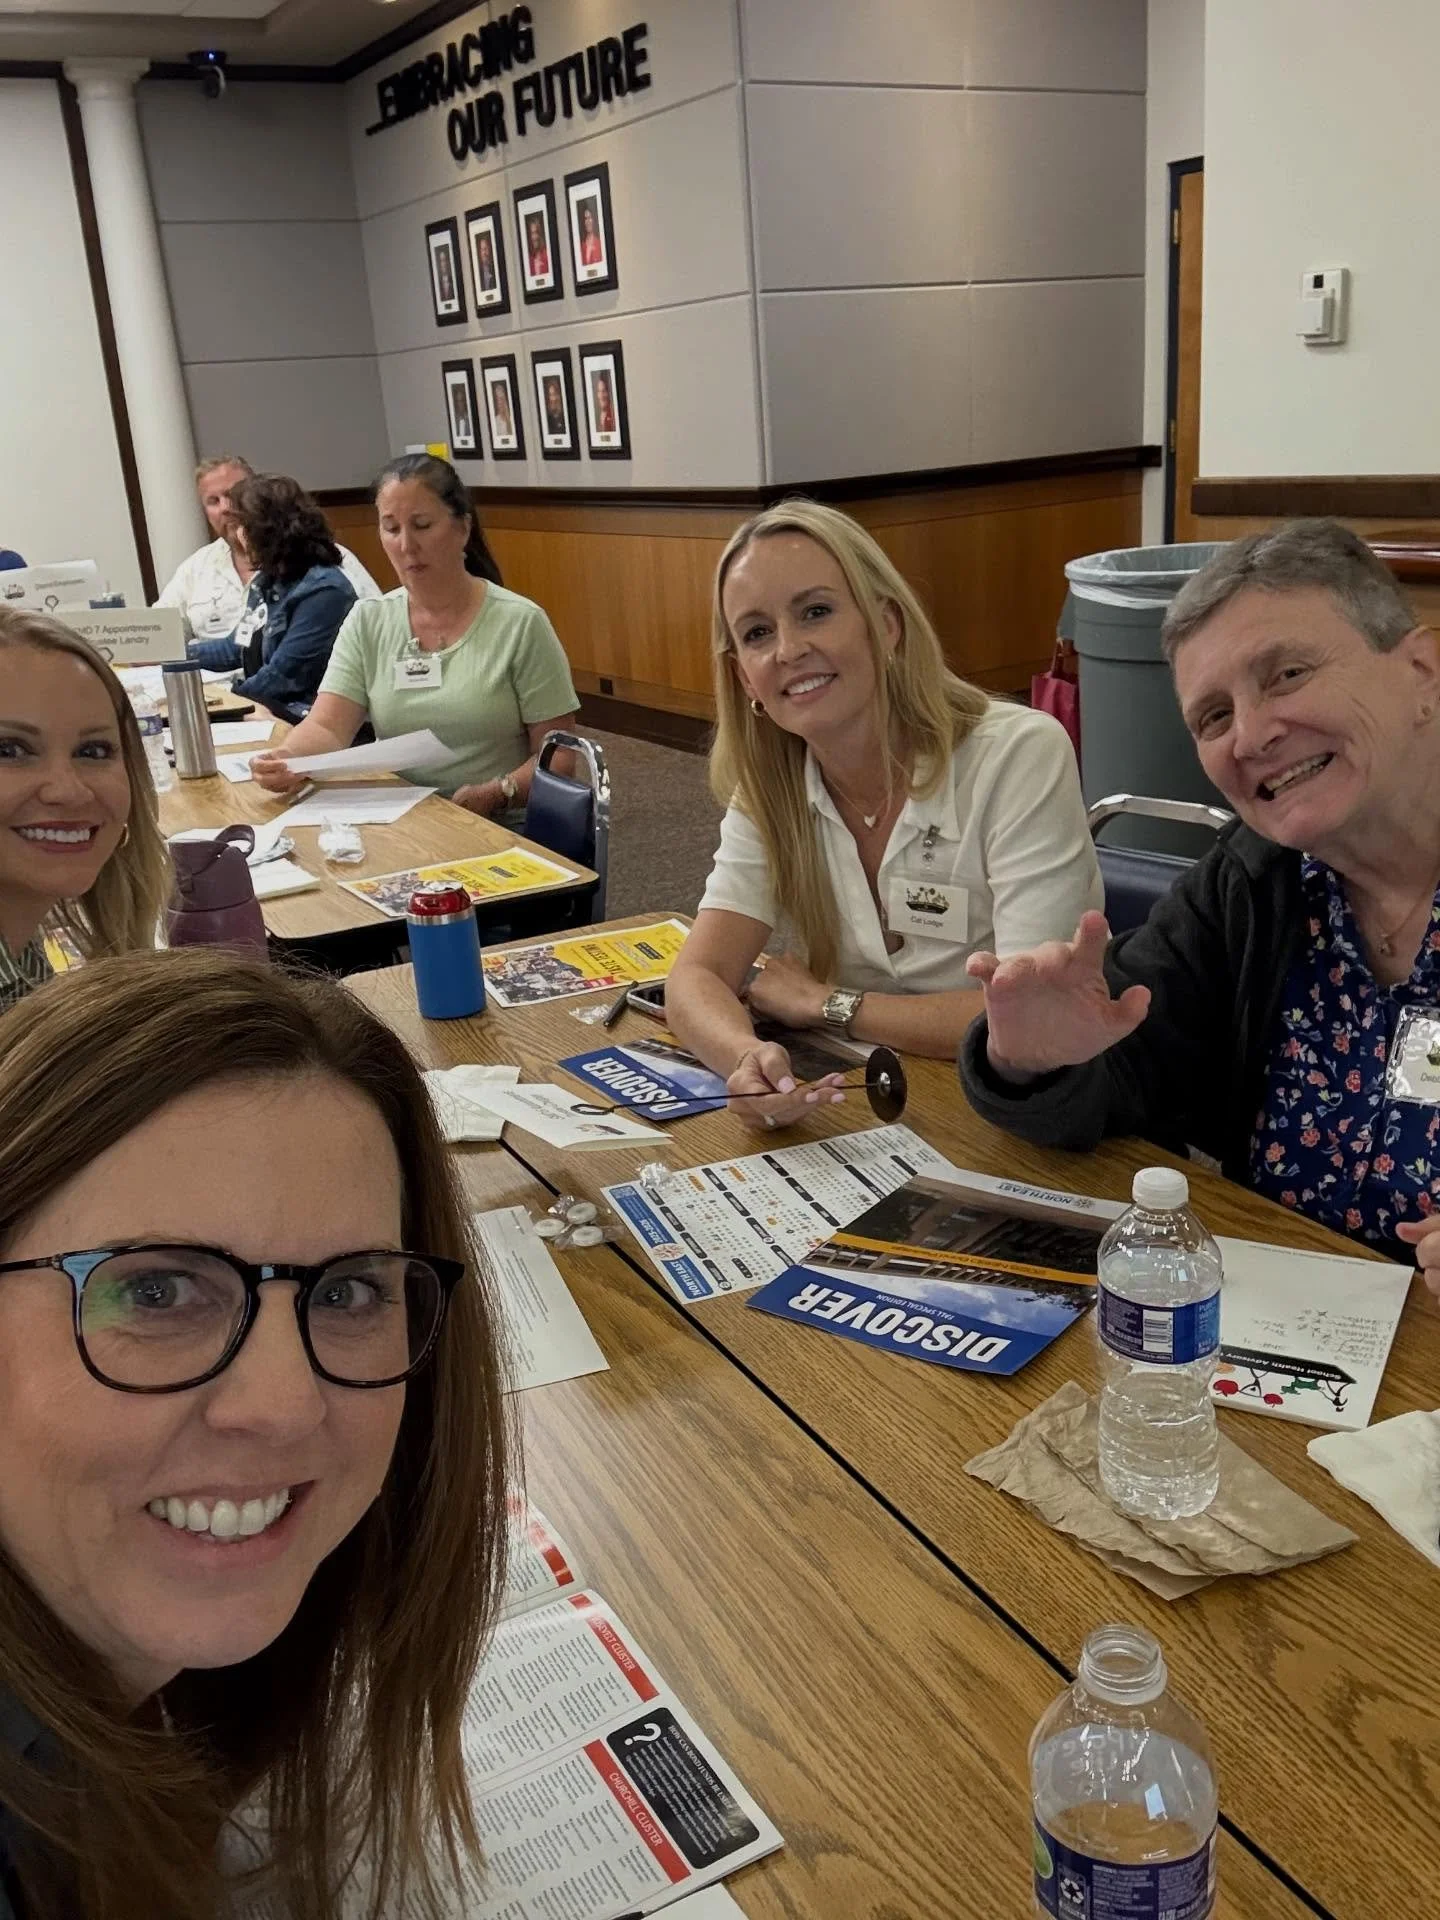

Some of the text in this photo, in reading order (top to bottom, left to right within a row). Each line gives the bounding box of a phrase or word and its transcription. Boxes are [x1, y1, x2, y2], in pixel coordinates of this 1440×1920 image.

[376, 5, 536, 124] EMBRACING
[447, 22, 651, 161] OUR FUTURE
[582, 1057, 690, 1114] DISCOVER
[788, 1284, 1012, 1363] DISCOVER
[876, 1294, 956, 1321] FALL SPECIAL EDITION
[1226, 1353, 1341, 1380] School Health Advisory
[611, 1643, 636, 1671] CLUSTER
[609, 1772, 640, 1814] CHURCHILL
[636, 1812, 662, 1846] CLUSTER
